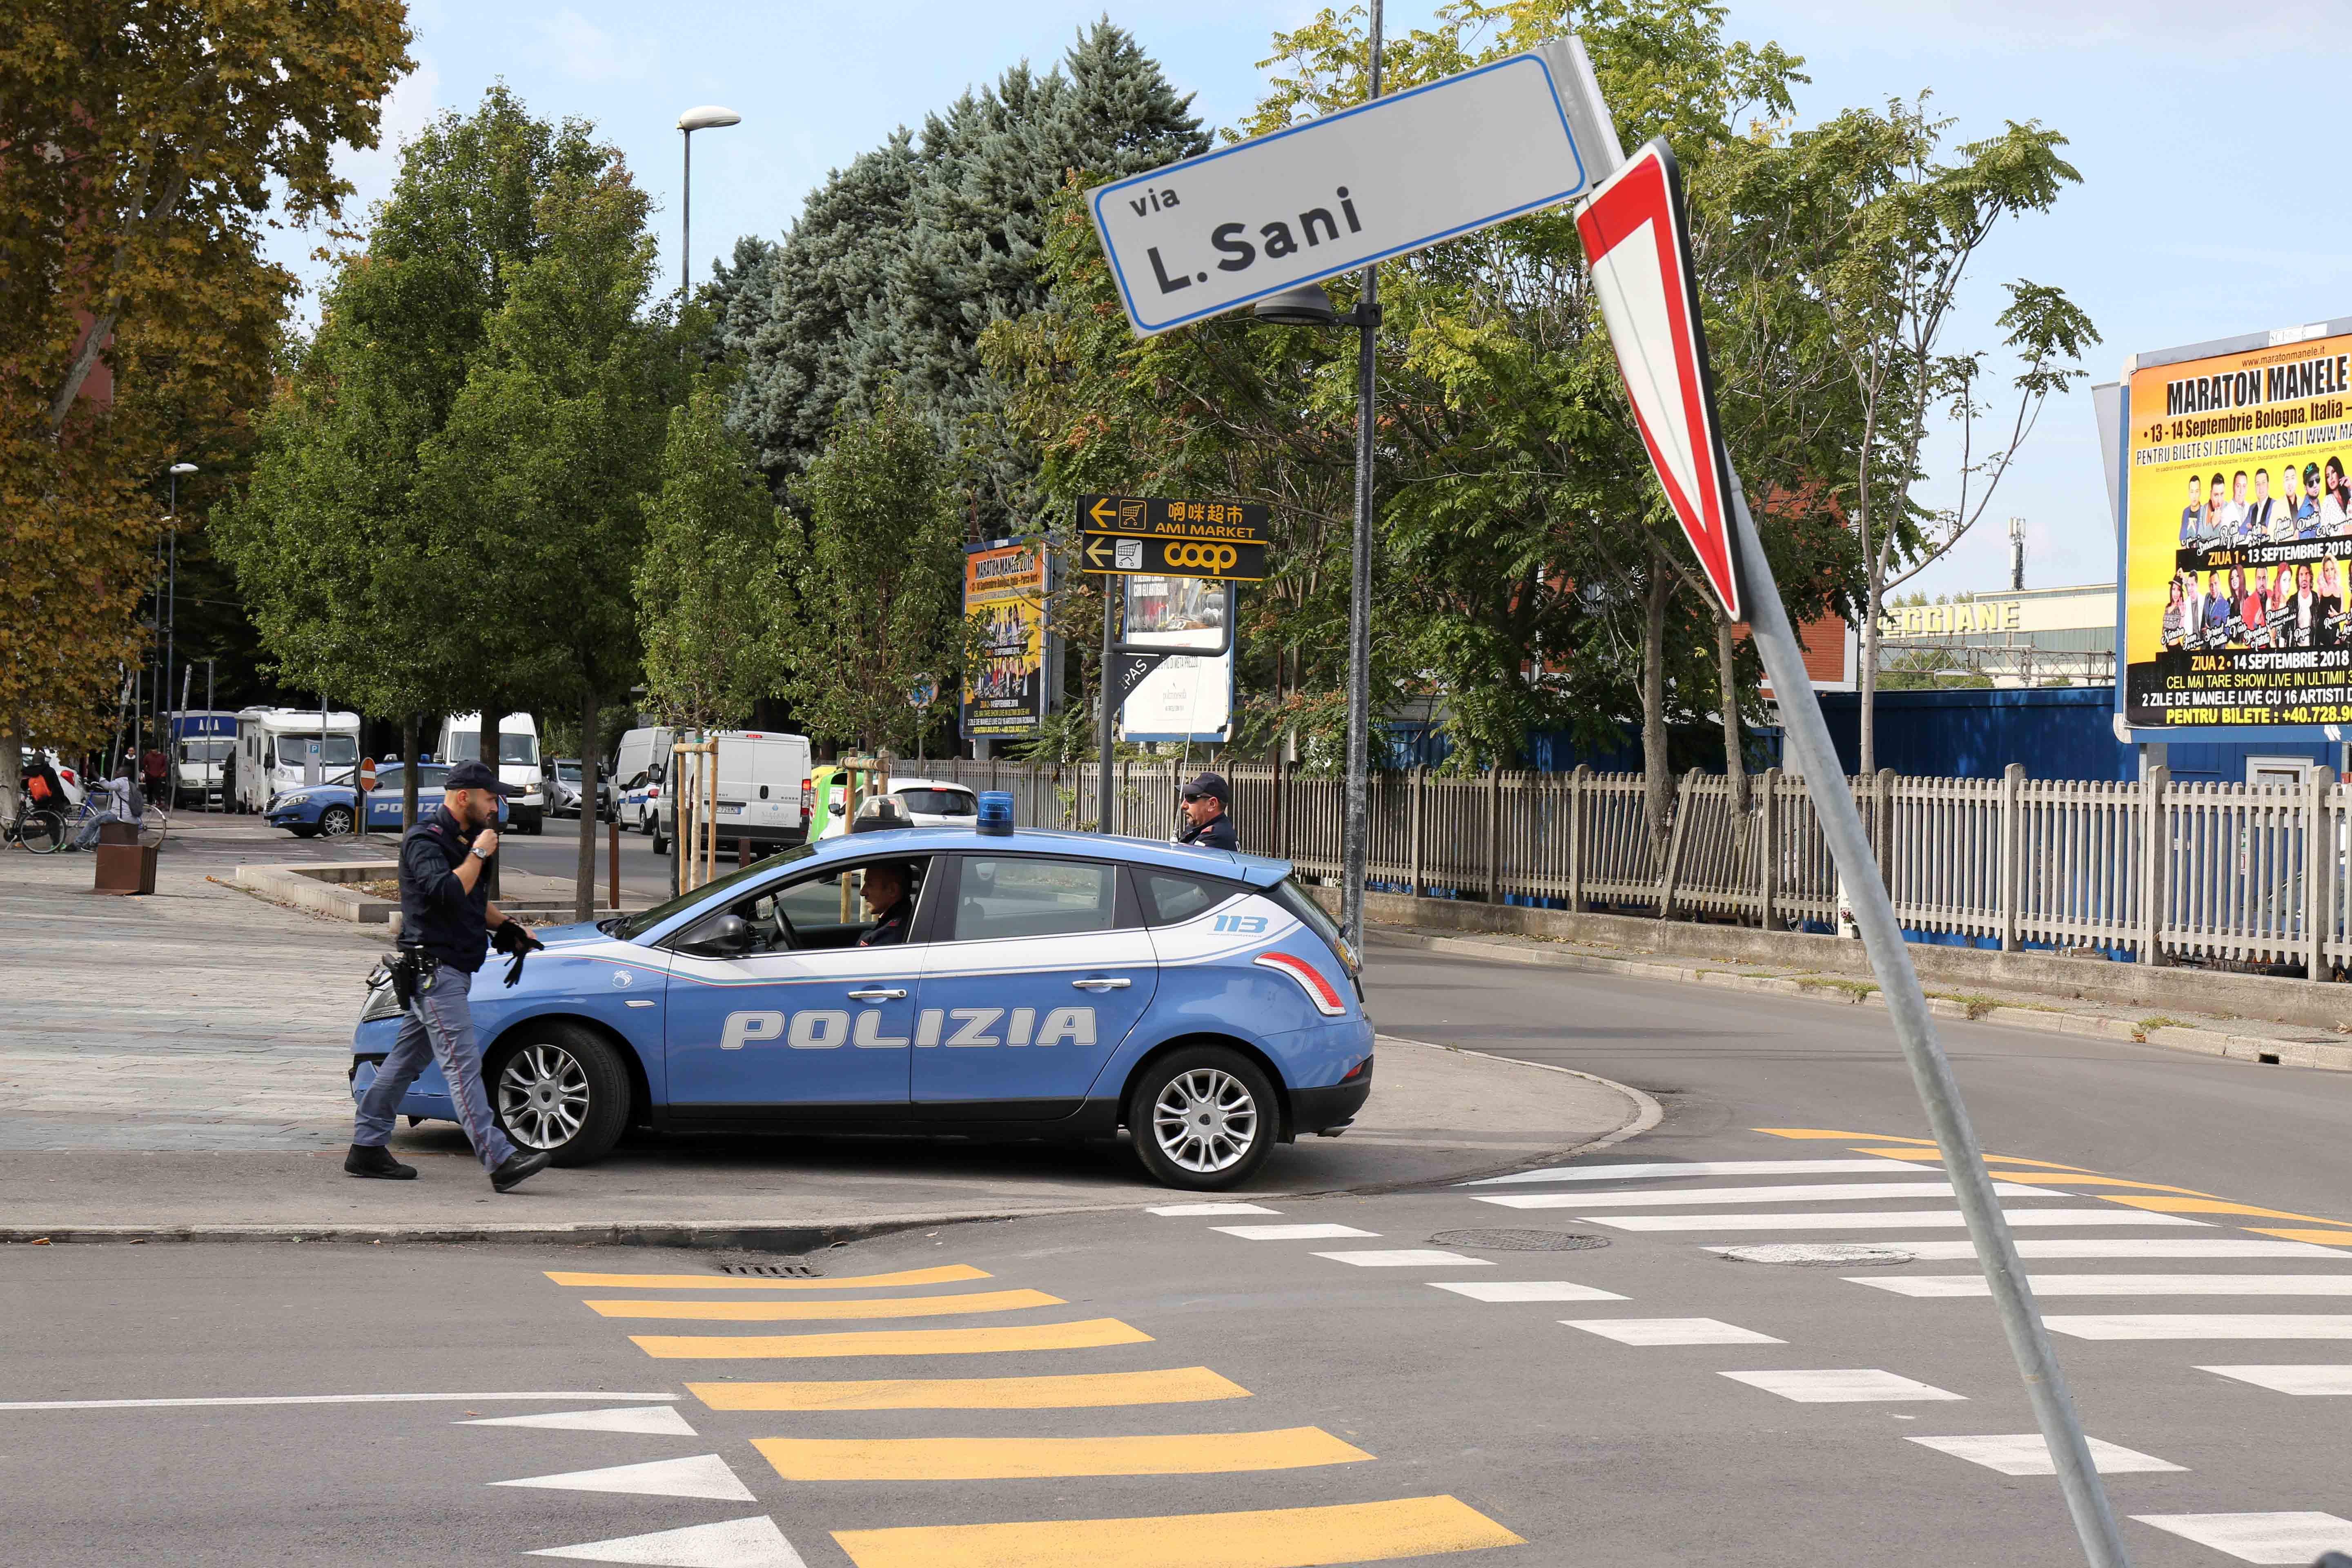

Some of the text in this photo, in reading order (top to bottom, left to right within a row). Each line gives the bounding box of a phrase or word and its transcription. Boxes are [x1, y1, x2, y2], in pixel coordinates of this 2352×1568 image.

[1129, 188, 1180, 217] via
[2242, 345, 2325, 367] www.maratonmanele.it
[2167, 356, 2347, 416] MARATON MANELE
[2150, 399, 2343, 443] 13 14 Septembrie Bologna, Italia
[2137, 447, 2170, 466] PENTRU
[2173, 443, 2201, 461] BILETE
[2203, 441, 2212, 457] SI
[2215, 437, 2253, 455] JETOANE
[2256, 430, 2303, 451] ACCESATI
[1156, 523, 1255, 538] AMI MARKET
[1164, 542, 1237, 575] coop
[2208, 540, 2352, 566] ZIUA 1 13 SEPTEMBRIE 2018
[1877, 602, 2018, 636] EGGIANE
[2192, 650, 2350, 671] ZIUA 2 14 SEPTEMBRIE 2018
[2167, 675, 2185, 689] CEL
[2187, 675, 2204, 688] MAI
[2206, 674, 2232, 688] TARE
[2234, 674, 2267, 687] SHOW
[2269, 673, 2291, 687] LIVE
[2294, 672, 2305, 686] IN
[2307, 670, 2345, 686] ULTIMII
[2142, 693, 2148, 707] 2
[2150, 692, 2173, 706] ZILE
[2175, 692, 2190, 706] DE
[2192, 690, 2236, 705] MANELE
[2238, 690, 2263, 704] LIVE
[2265, 690, 2281, 705] CU
[2285, 689, 2297, 704] 16
[2299, 688, 2344, 704] ARTISTI
[2166, 708, 2218, 724] PENTRU
[2222, 707, 2270, 724] BILETE
[1214, 915, 1268, 933] 113
[720, 1007, 1096, 1050] POLIZIA
